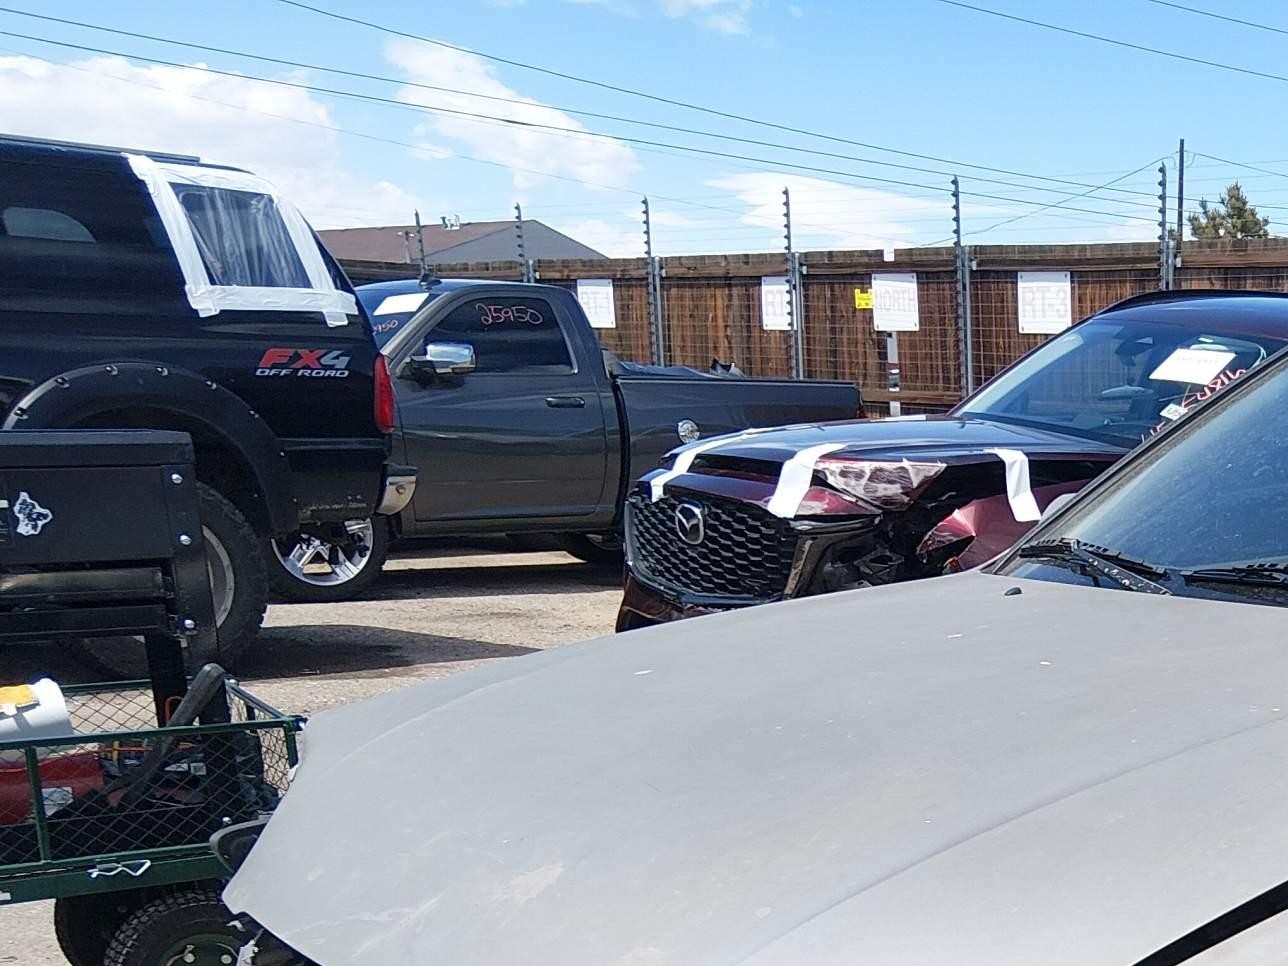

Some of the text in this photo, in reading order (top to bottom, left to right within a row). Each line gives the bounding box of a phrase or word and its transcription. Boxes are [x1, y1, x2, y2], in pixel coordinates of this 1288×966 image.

[1022, 287, 1067, 318] RT-3
[475, 303, 543, 325] 25950
[259, 348, 351, 369] FX4
[255, 368, 349, 378] OFF ROAD
